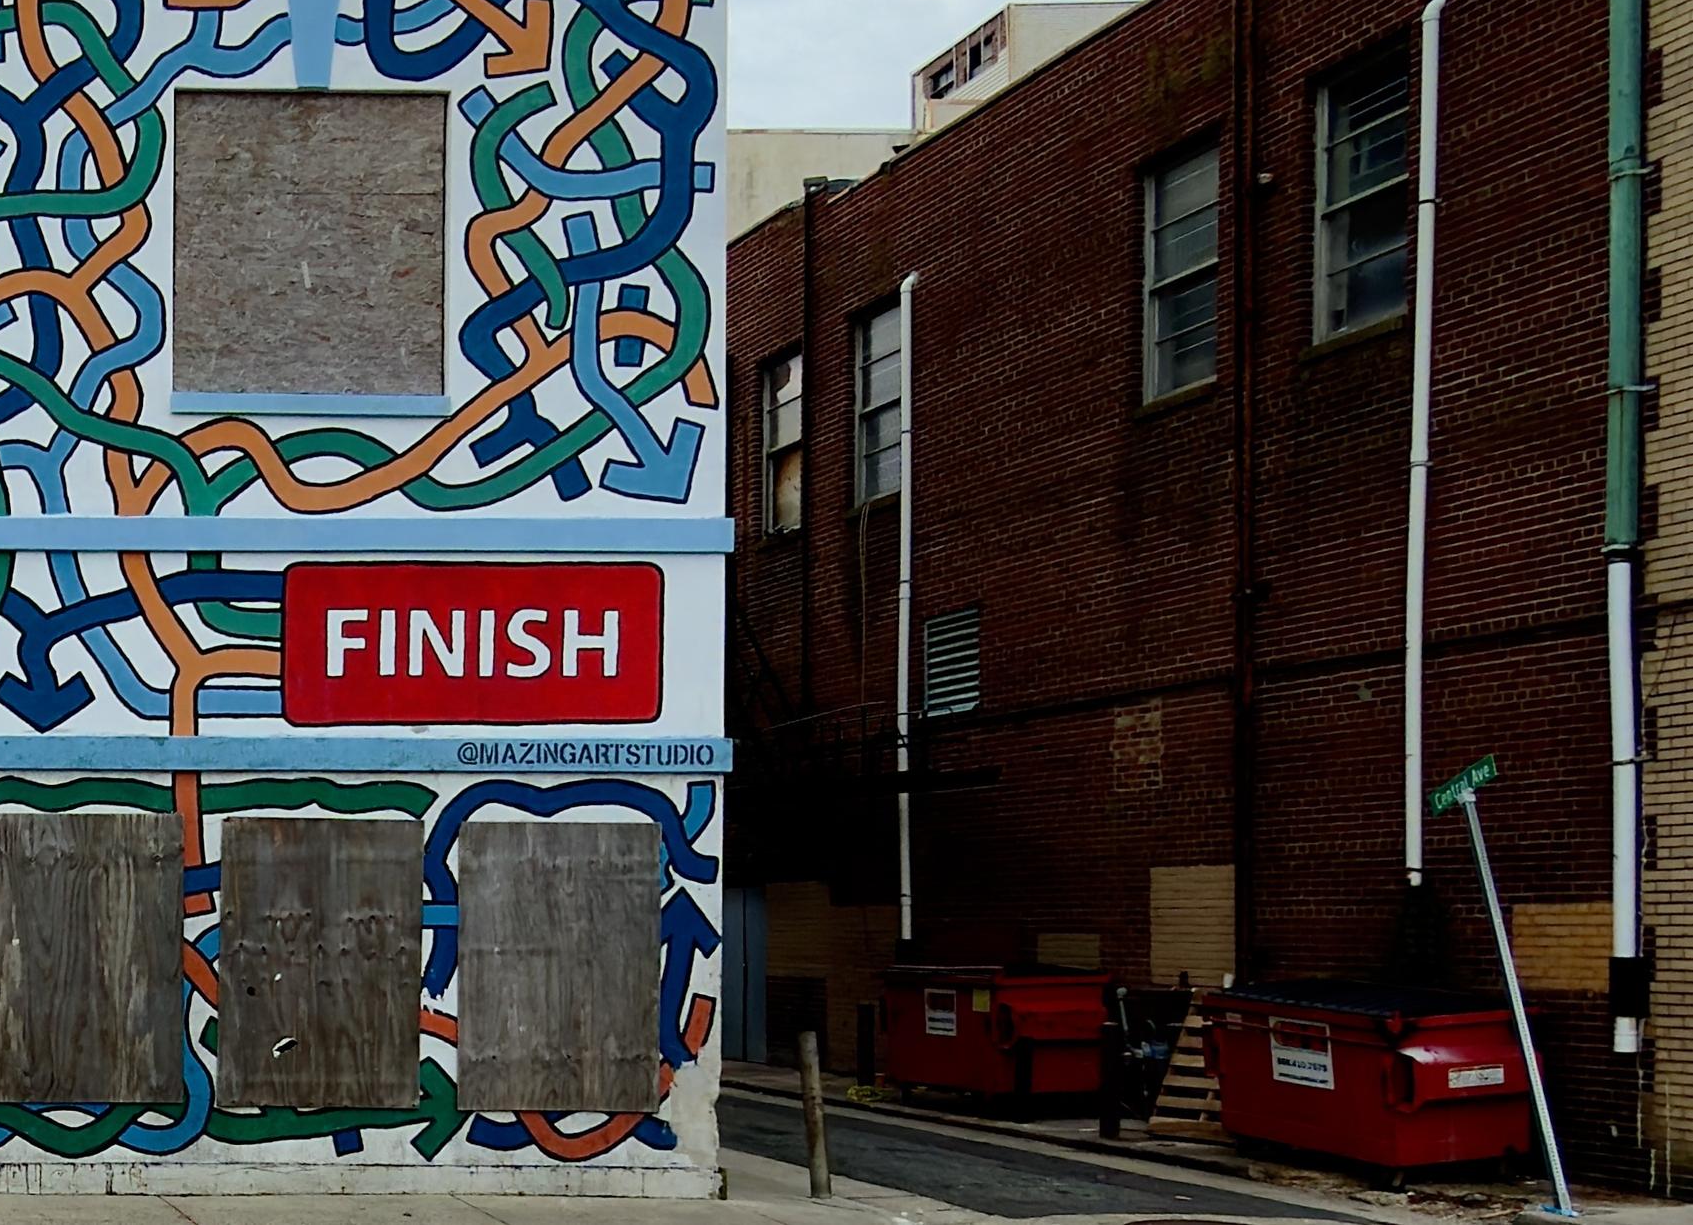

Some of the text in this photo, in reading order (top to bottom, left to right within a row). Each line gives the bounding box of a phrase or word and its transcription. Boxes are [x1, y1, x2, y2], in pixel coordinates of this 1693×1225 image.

[326, 608, 620, 678] FINISH
[457, 741, 714, 765] @MAZINGARTSTUDIO
[1435, 765, 1490, 809] Central Ave
